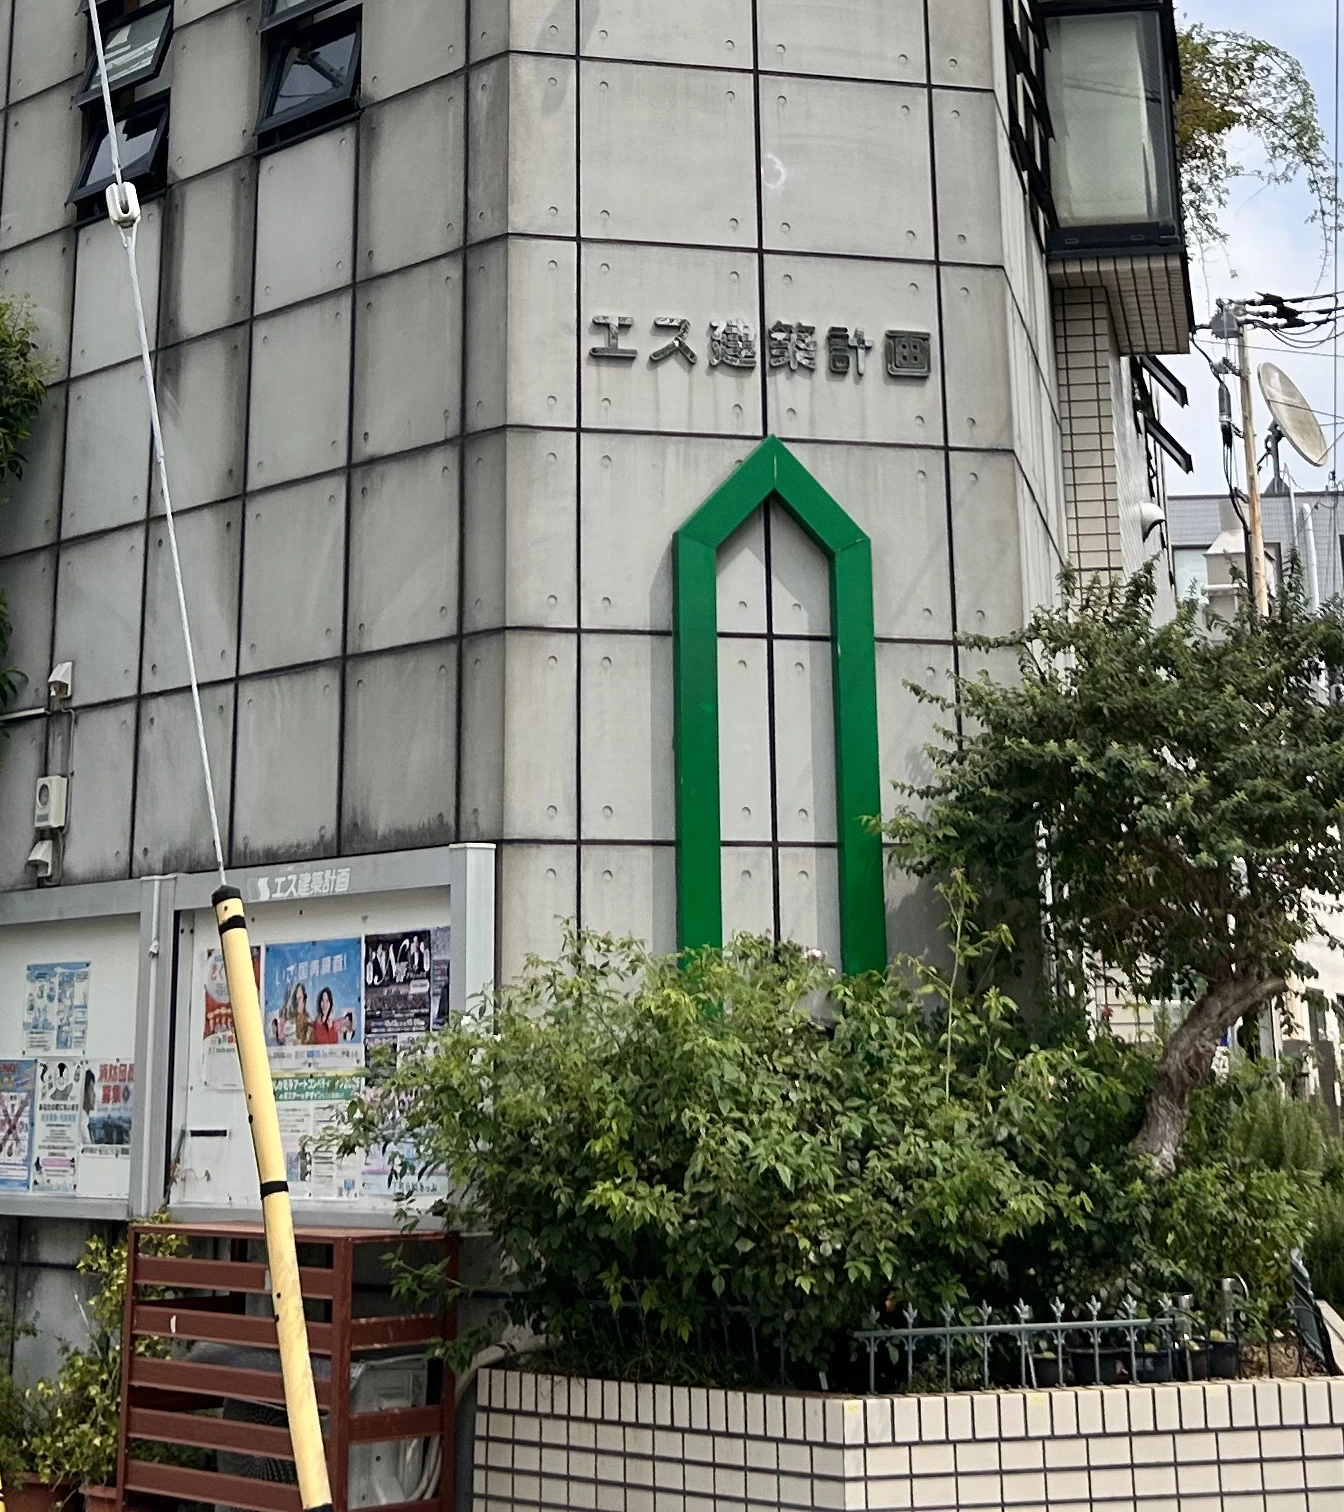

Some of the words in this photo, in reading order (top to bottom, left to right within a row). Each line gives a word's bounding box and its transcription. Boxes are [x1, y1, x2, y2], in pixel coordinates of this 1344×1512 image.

[589, 315, 932, 378] エス建築計画
[271, 868, 352, 899] エス建築計画
